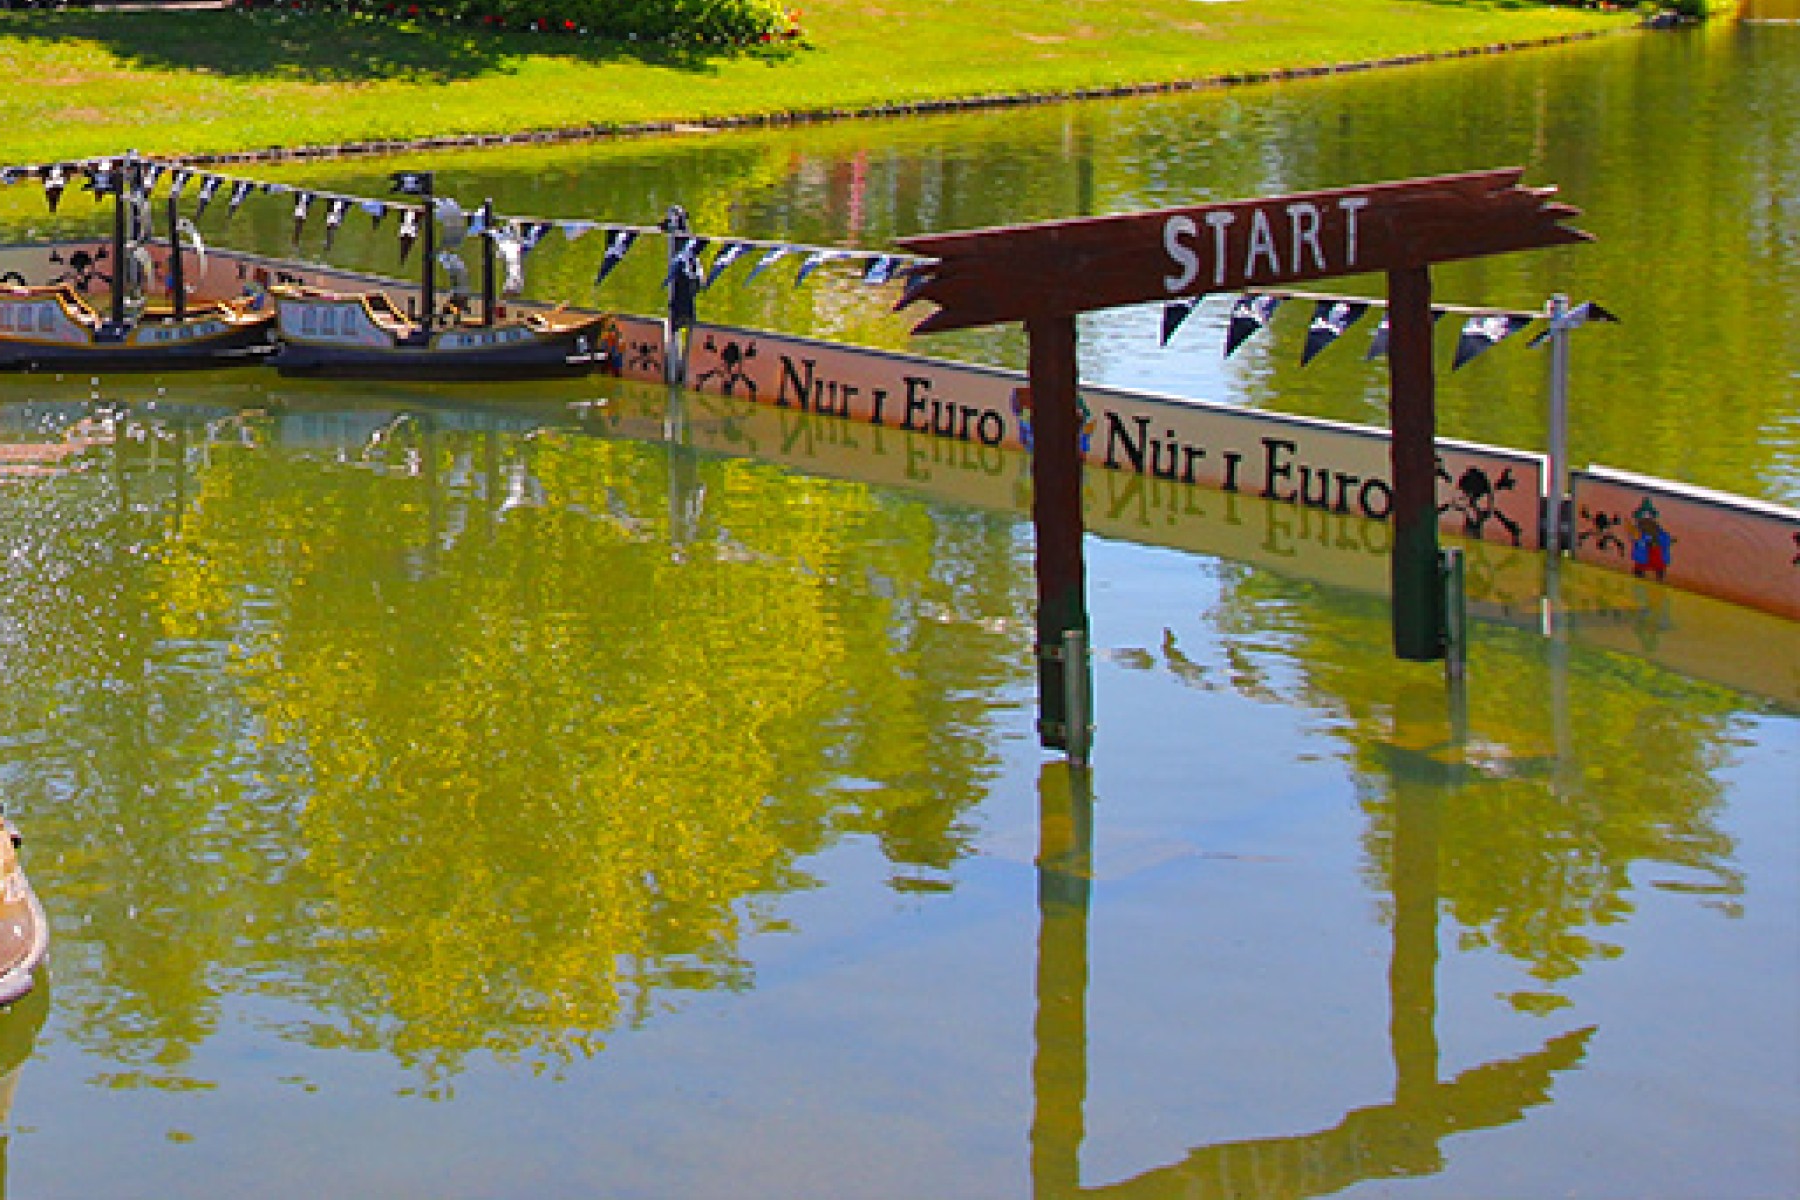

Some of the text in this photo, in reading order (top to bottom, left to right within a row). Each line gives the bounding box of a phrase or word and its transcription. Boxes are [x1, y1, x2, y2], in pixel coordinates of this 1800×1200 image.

[1163, 197, 1369, 293] START
[773, 353, 858, 419] Nur
[900, 376, 1007, 448] Euro
[1259, 437, 1394, 522] Euro
